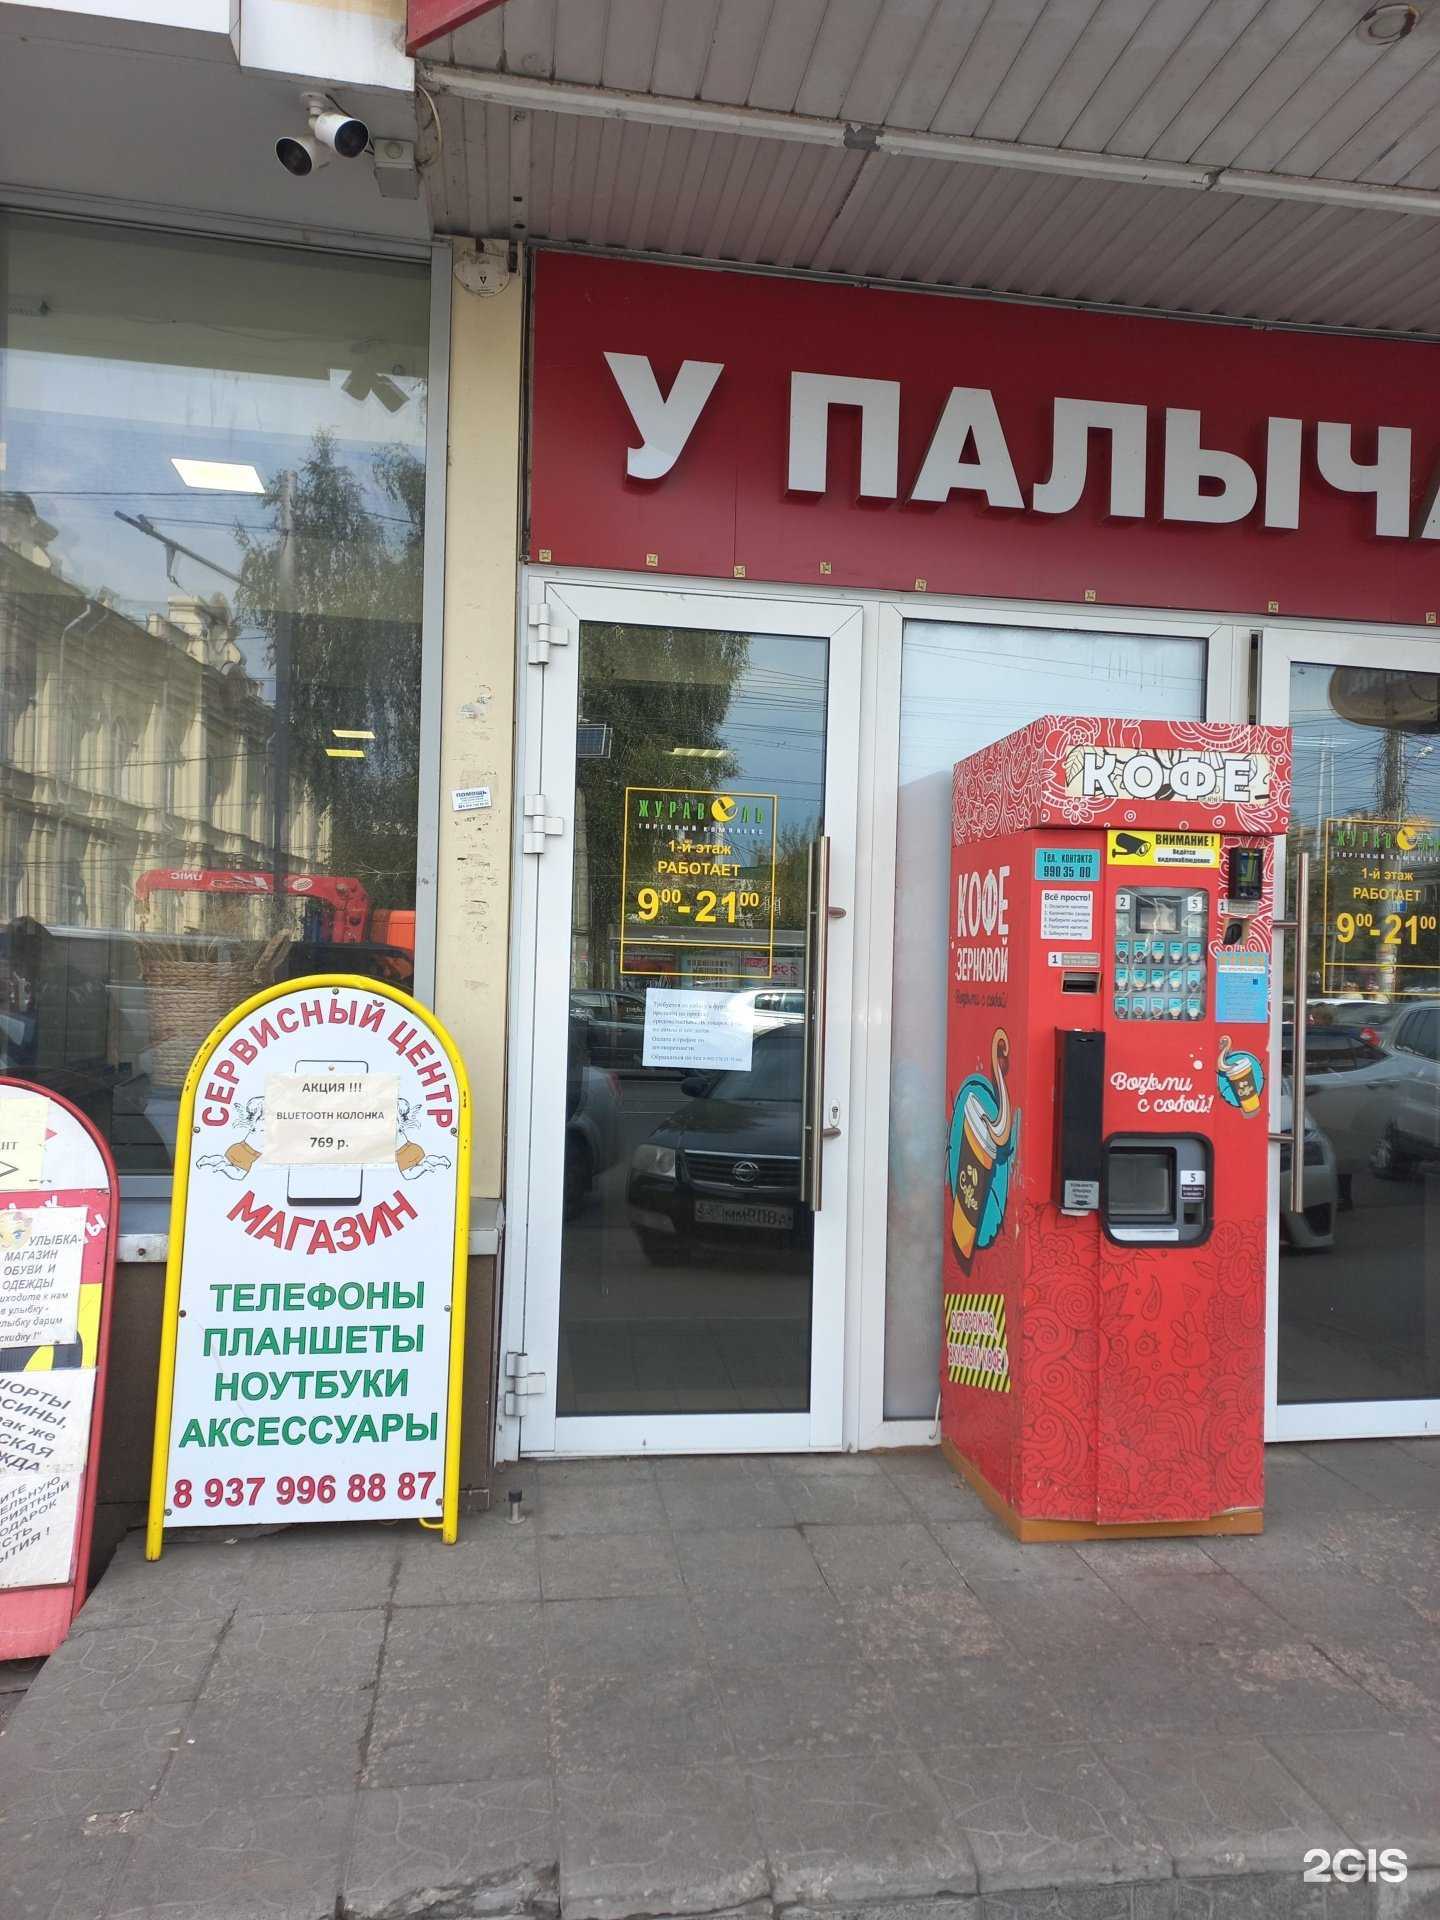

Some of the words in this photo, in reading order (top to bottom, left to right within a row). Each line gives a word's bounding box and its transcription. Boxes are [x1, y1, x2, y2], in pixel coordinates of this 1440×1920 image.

[603, 351, 725, 480] У
[1083, 752, 1250, 803] КОФЕ
[668, 839, 692, 853] 1-й
[695, 844, 731, 855] этаж
[1062, 854, 1093, 864] контакта
[658, 861, 741, 876] РАБОТАЕТ
[1063, 866, 1074, 878] 35
[1361, 867, 1381, 880] 1-й
[1384, 871, 1414, 881] этаж
[957, 865, 1010, 938] КОФЕ
[1045, 892, 1059, 901] Всё
[1060, 893, 1091, 903] просто!
[1353, 887, 1421, 901] РАБОТАЕТ
[955, 936, 1009, 983] ЗЕРНОВОЙ
[202, 998, 387, 1127] СЕРВИСНЫЙ
[387, 1020, 454, 1128] ЦЕНТР
[302, 1083, 345, 1094] АКЦИЯ
[349, 1082, 362, 1093] !!!
[1110, 1072, 1192, 1095] Возьми
[1137, 1099, 1150, 1113] с
[1153, 1095, 1214, 1113] собой!
[336, 1111, 384, 1120] КОЛОНКА
[310, 1137, 334, 1148] 769
[337, 1140, 349, 1150] р.
[227, 1190, 418, 1255] МАГАЗИН
[5, 1250, 58, 1262] МАГАЗИН
[3, 1264, 42, 1276] ОБУВИ
[48, 1264, 56, 1273] И
[2, 1279, 54, 1292] ОДЕЖДЫ
[210, 1281, 425, 1312] ТЕЛЕФОНЫ
[8, 1304, 43, 1316] улыбку
[33, 1317, 63, 1327] дарим
[203, 1324, 424, 1357] ПЛАНШЕТЫ
[214, 1368, 409, 1402] НОУТБУКИ
[28, 1427, 56, 1441] же
[178, 1412, 438, 1448] АКСЕССУАРЫ
[173, 1479, 192, 1508] 8
[204, 1477, 266, 1507] 937
[276, 1475, 336, 1505] 996
[347, 1473, 386, 1502] 88
[397, 1471, 436, 1500] 87
